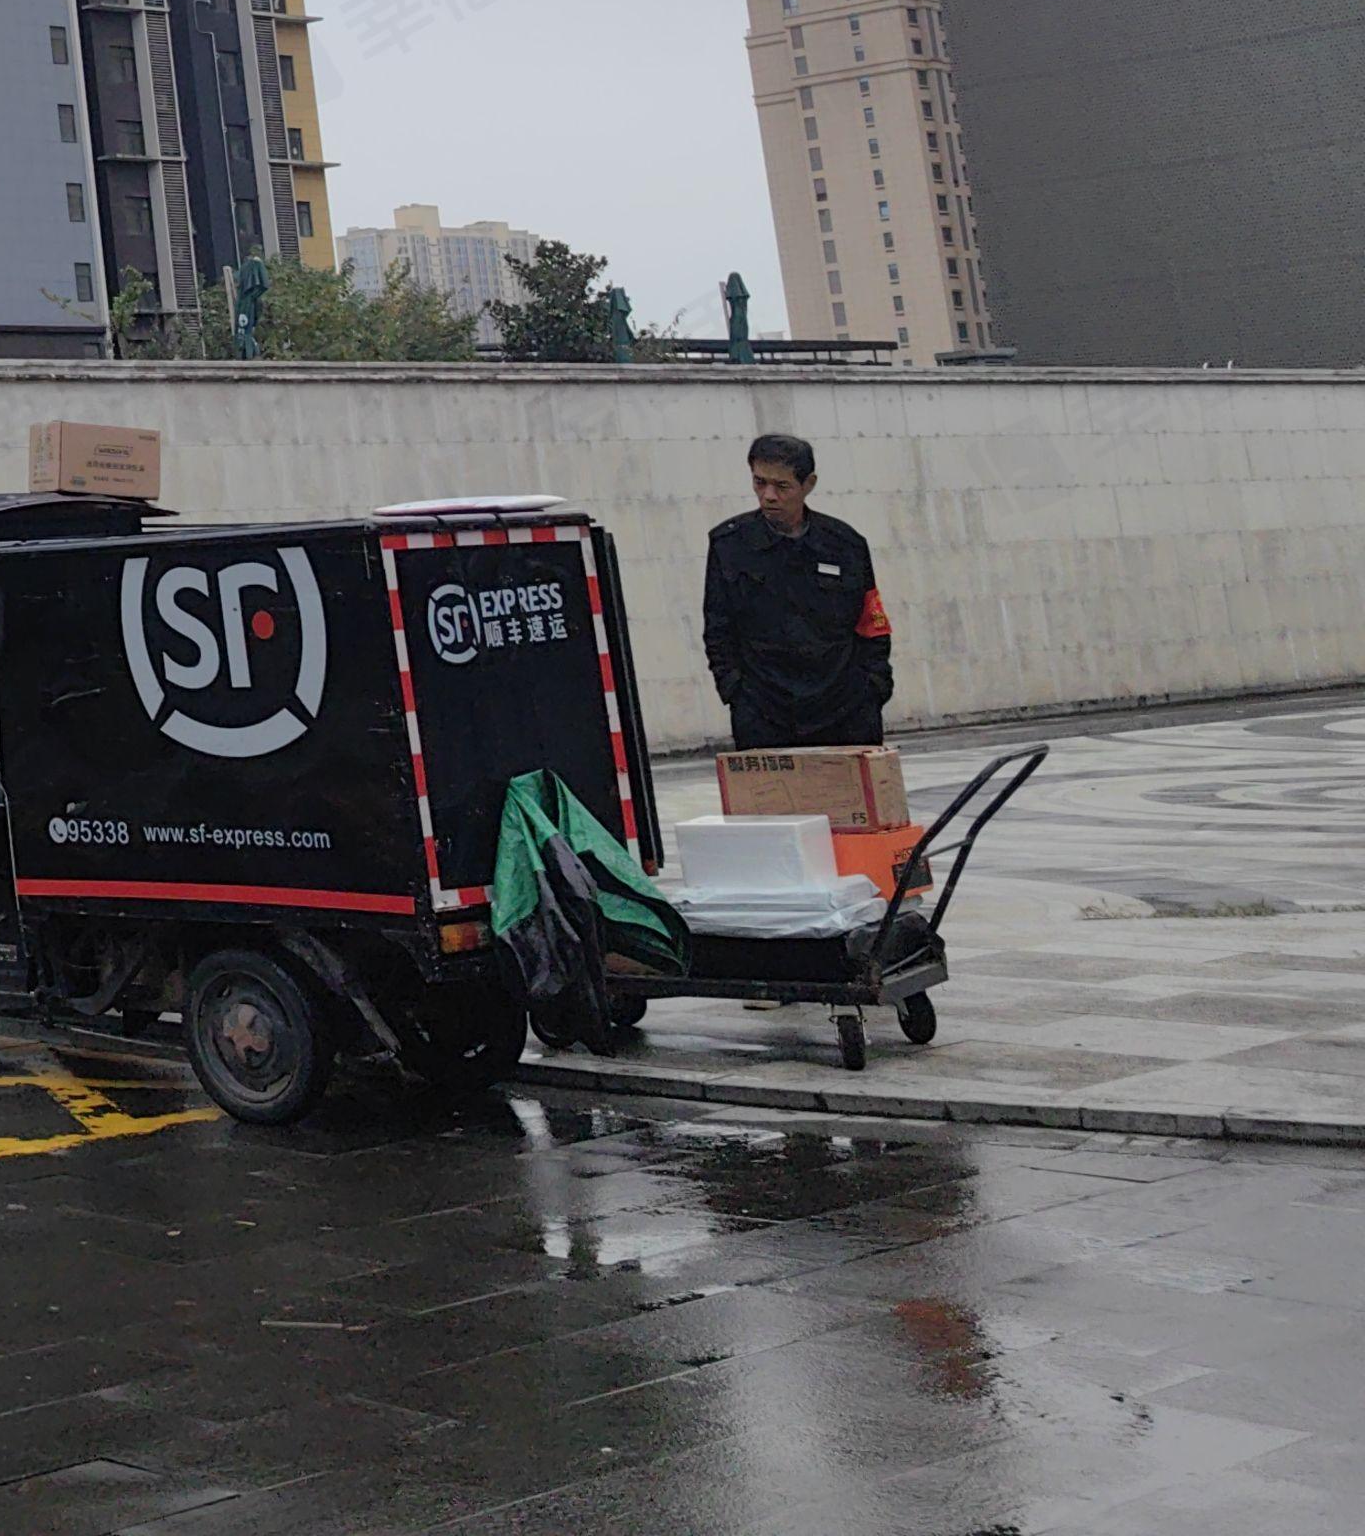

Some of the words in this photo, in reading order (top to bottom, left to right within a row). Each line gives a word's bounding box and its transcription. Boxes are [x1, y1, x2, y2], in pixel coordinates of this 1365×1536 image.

[479, 582, 564, 618] EXPRESS
[483, 613, 568, 648] 顺丰速运
[67, 819, 130, 845] 95338
[142, 823, 331, 850] www.sf-express.com
